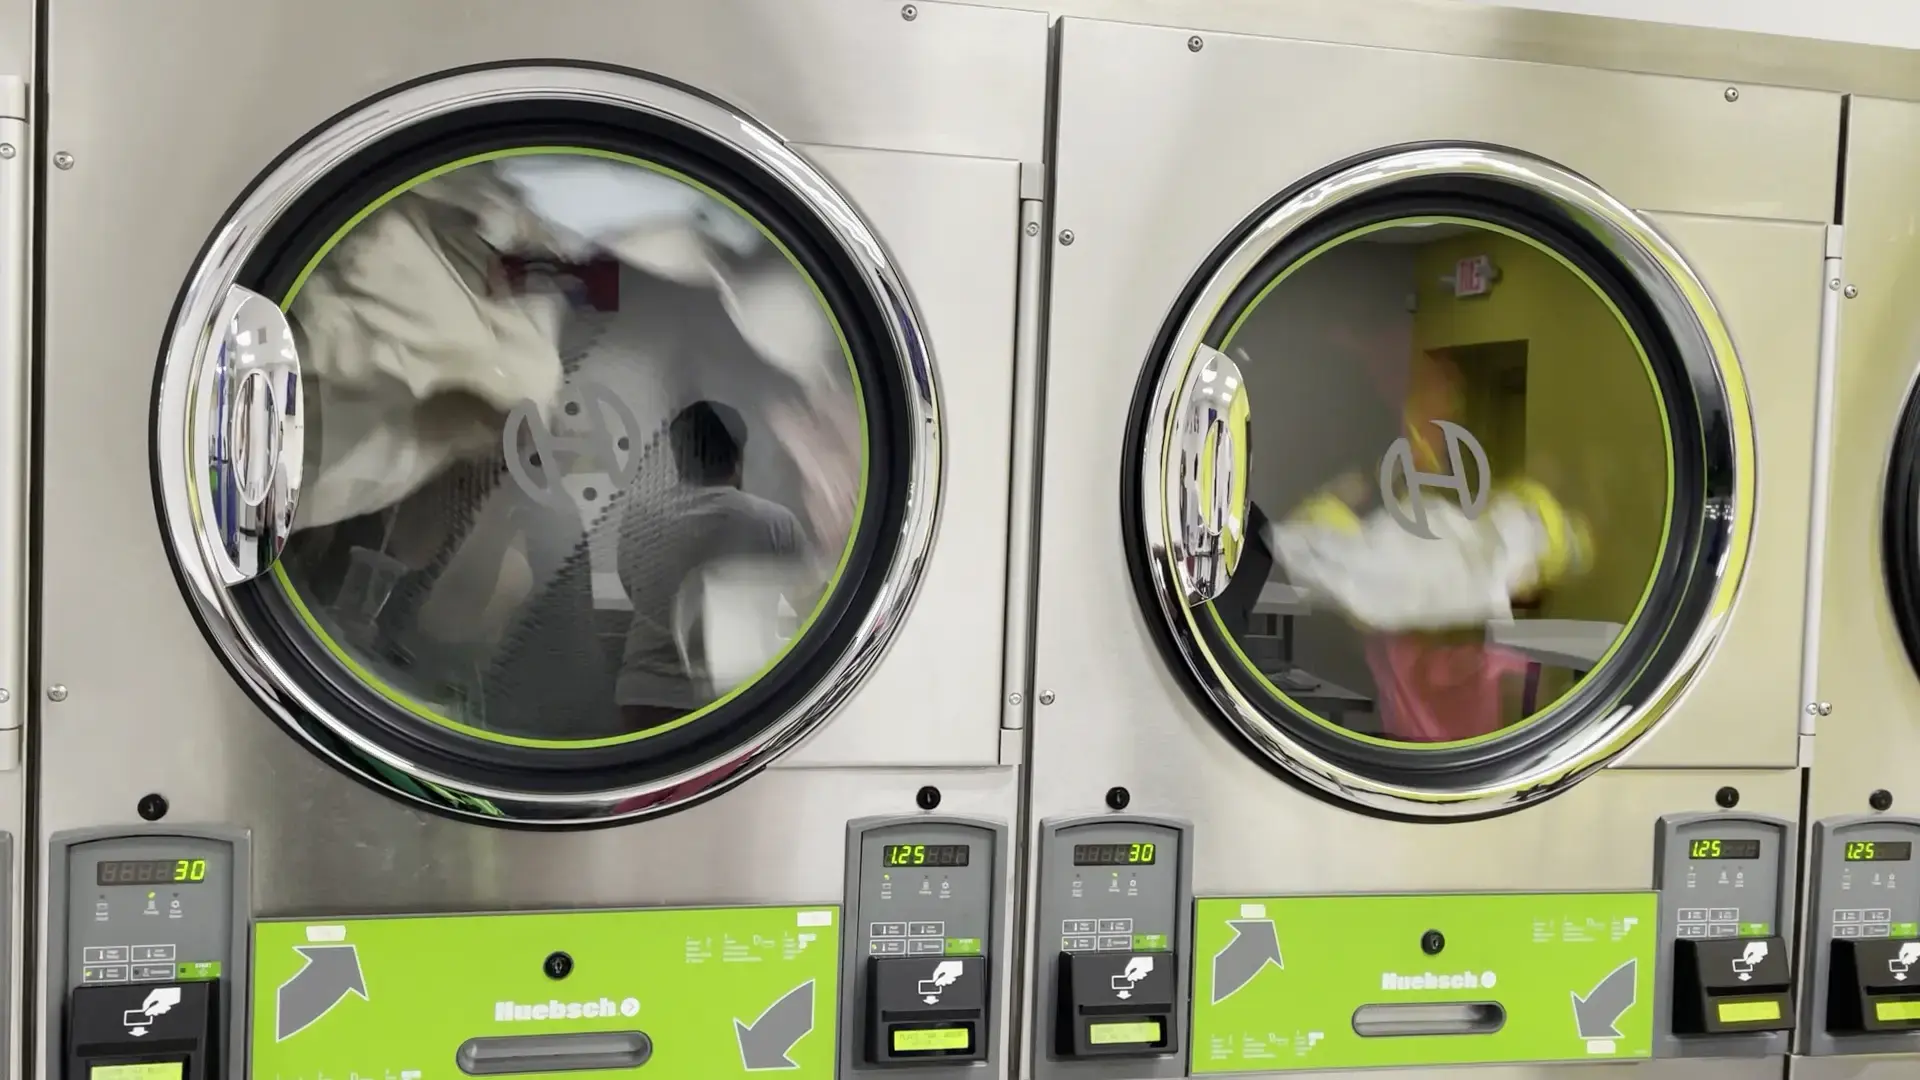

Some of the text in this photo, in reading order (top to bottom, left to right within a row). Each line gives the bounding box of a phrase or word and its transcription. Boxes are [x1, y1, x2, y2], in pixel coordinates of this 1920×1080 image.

[892, 846, 924, 865] 1.25
[1130, 844, 1153, 862] 30
[1692, 841, 1721, 857] 1.25
[175, 860, 205, 881] 30
[494, 998, 616, 1021] Huebsch
